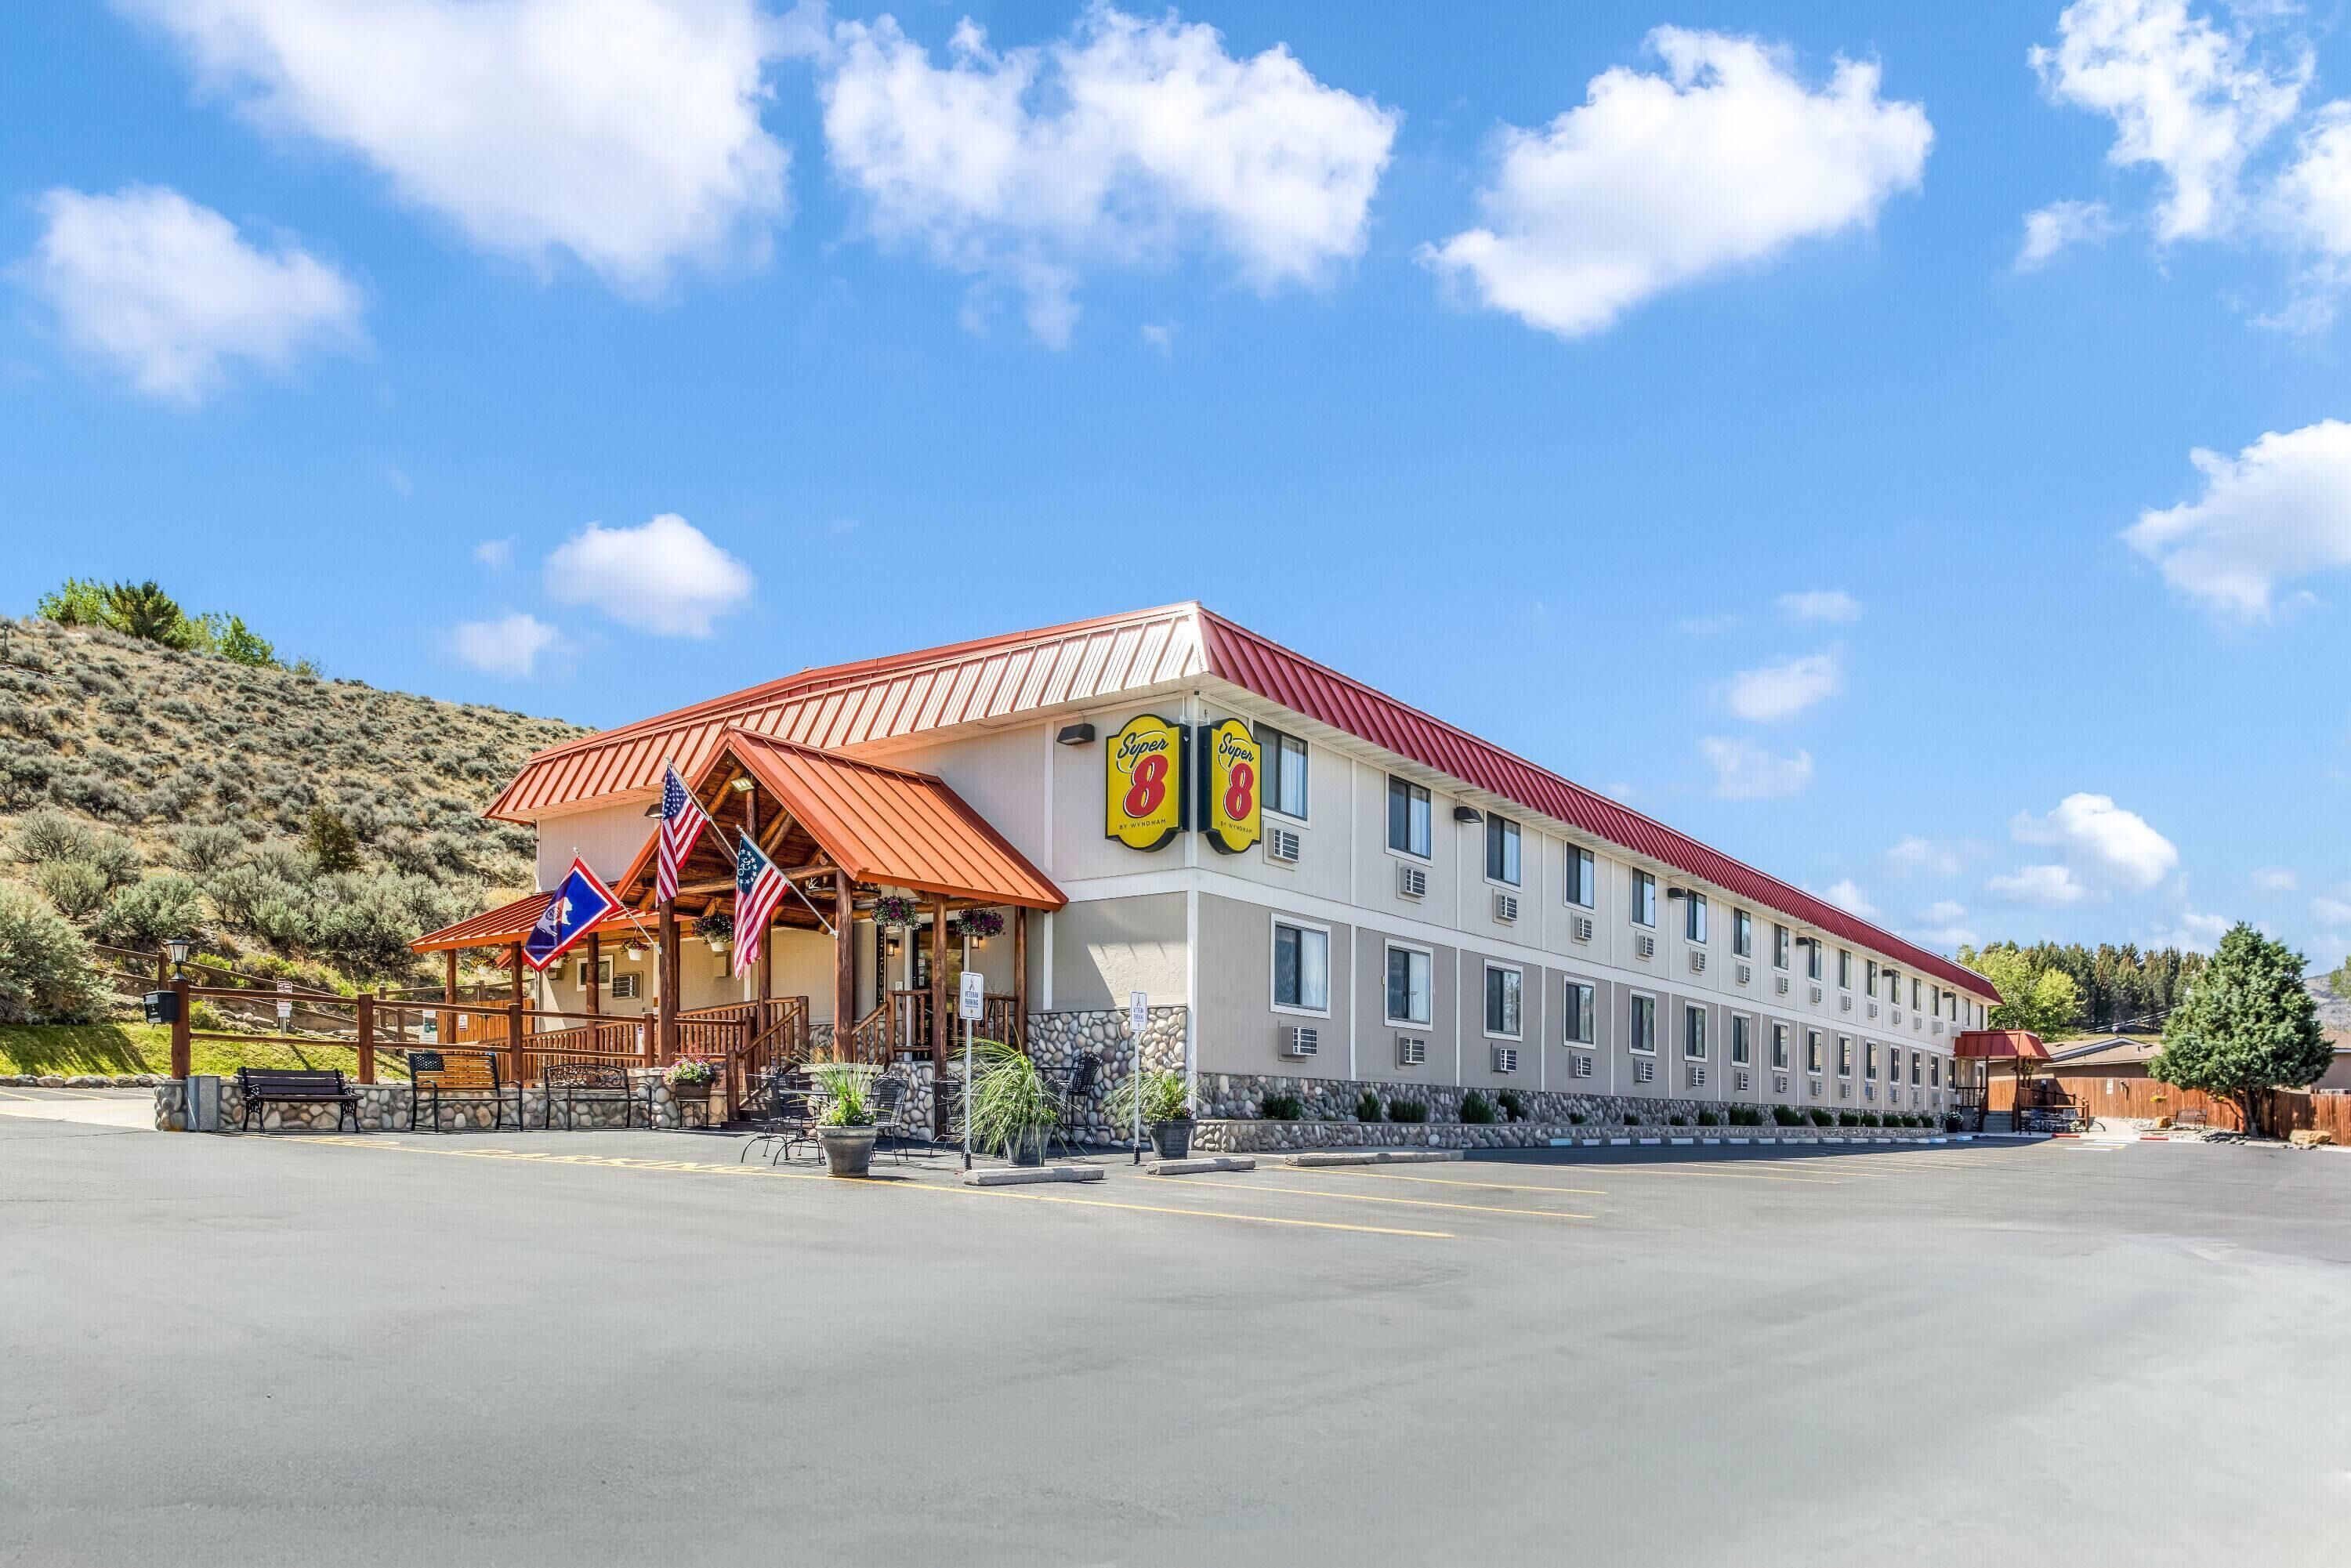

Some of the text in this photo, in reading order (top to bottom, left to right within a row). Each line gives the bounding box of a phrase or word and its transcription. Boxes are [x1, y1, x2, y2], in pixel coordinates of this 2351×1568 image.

[1117, 732, 1168, 769] Super
[1219, 732, 1254, 768] Super
[1123, 754, 1168, 818] 8
[1223, 762, 1254, 821] 8
[1130, 819, 1166, 828] WYNDHAM
[1228, 823, 1252, 833] WYNDHAM
[450, 1149, 768, 1171] PARKING
